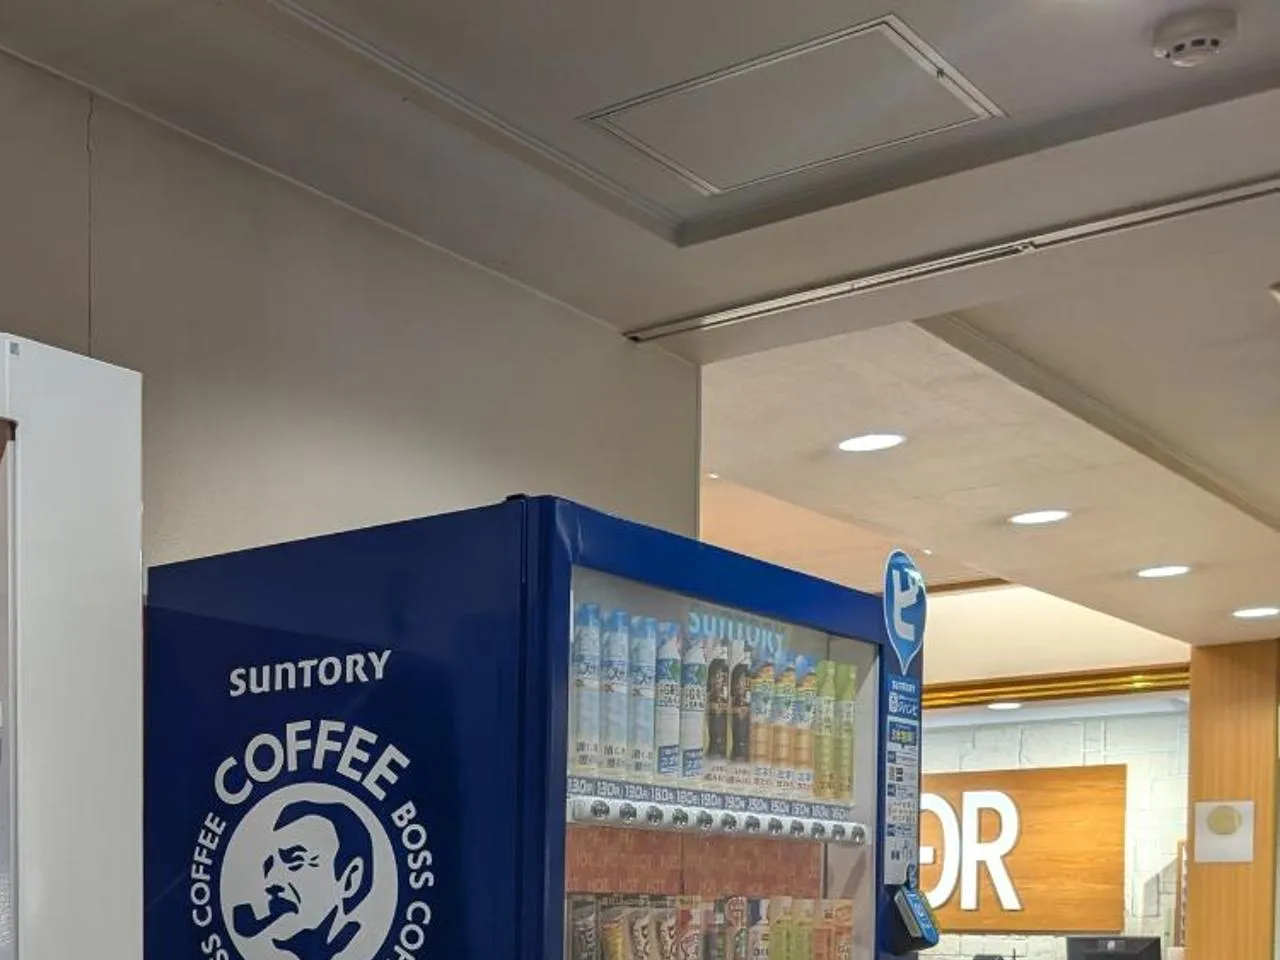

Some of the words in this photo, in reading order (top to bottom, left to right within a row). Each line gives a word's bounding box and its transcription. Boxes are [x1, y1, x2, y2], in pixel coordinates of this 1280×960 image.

[230, 649, 392, 697] SUNTORY
[214, 719, 410, 805] COFFEE
[190, 811, 227, 927] COFFEE
[391, 800, 435, 889] BOSS
